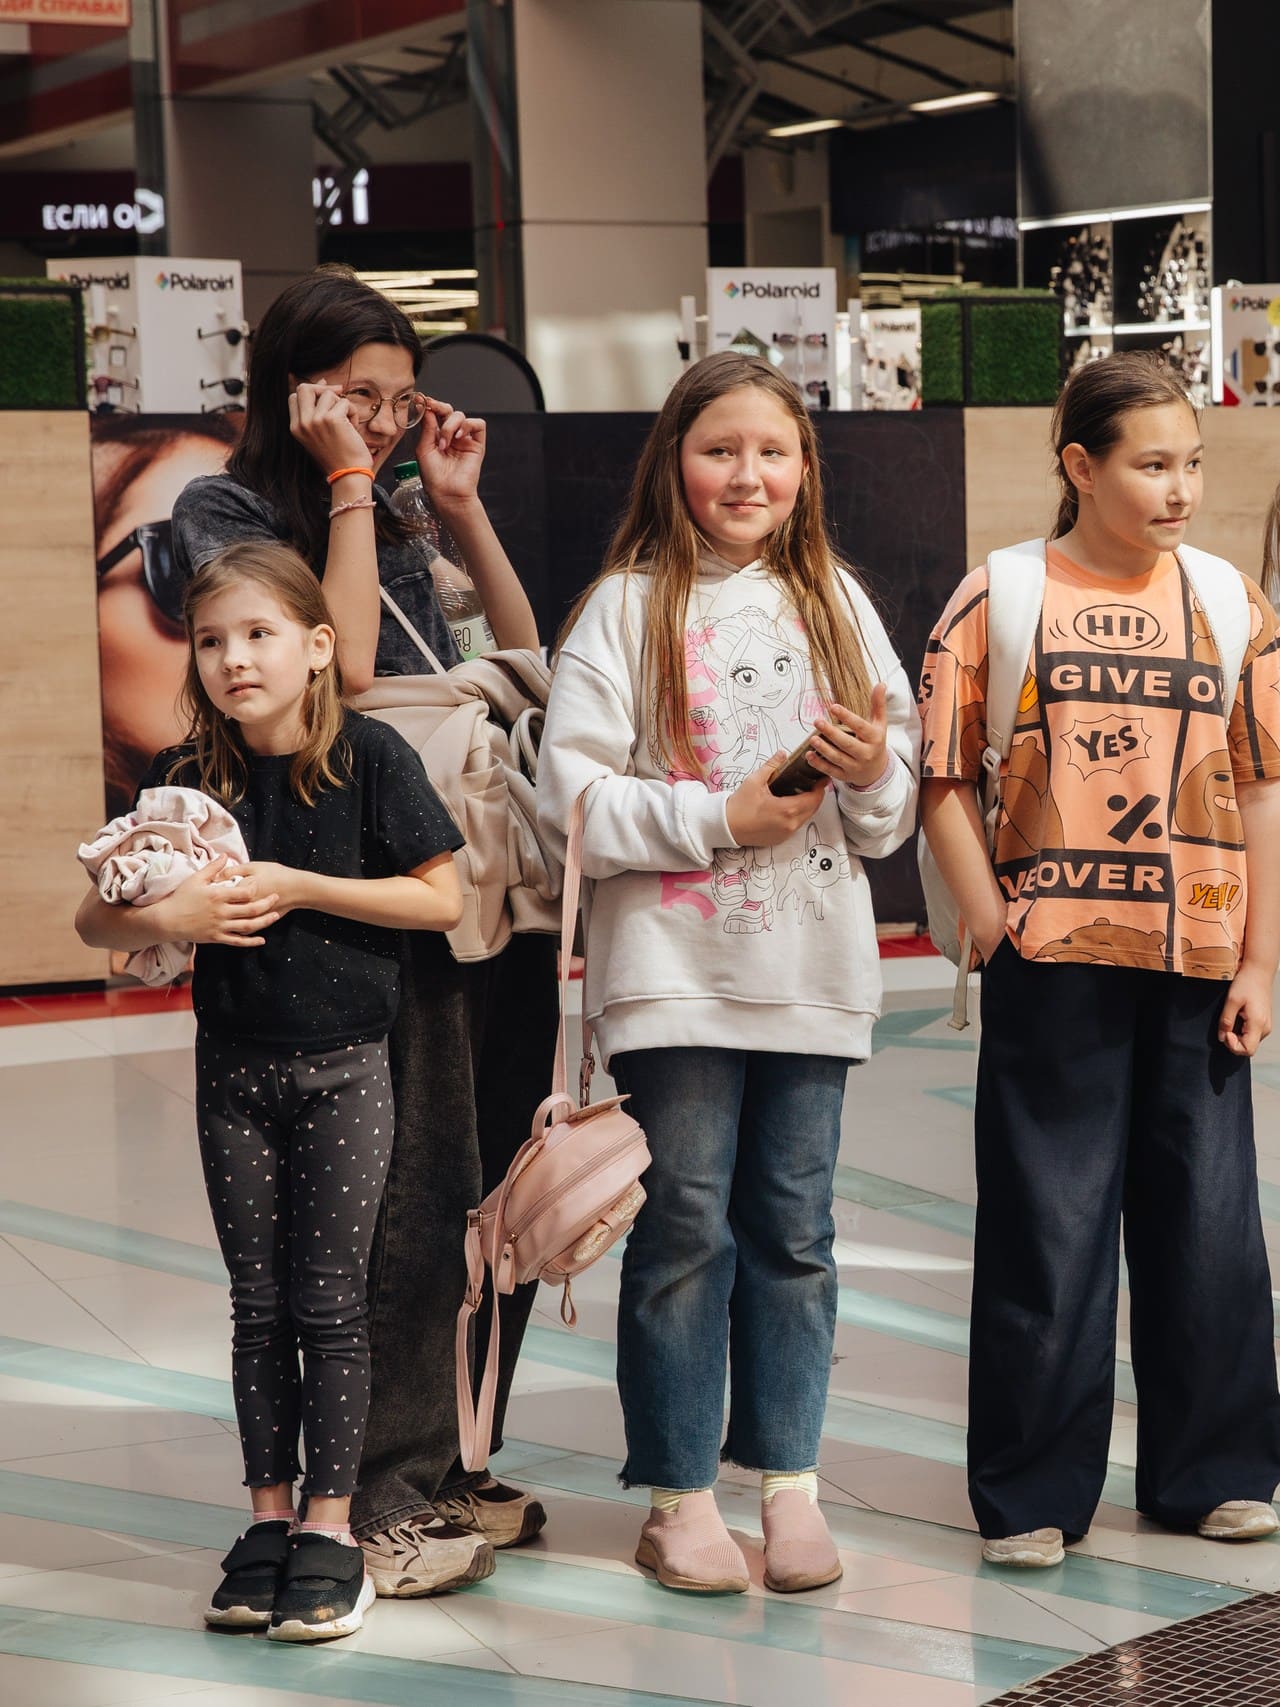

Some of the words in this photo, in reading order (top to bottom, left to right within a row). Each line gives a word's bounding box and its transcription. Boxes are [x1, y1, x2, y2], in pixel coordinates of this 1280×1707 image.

[42, 204, 109, 231] ЕСЛИ
[170, 272, 234, 291] Polaroid
[741, 282, 820, 300] Polaroid
[1086, 614, 1146, 642] HI!
[1050, 663, 1172, 698] GIVE
[1187, 674, 1225, 704] O
[1074, 724, 1140, 763] YES
[1037, 860, 1166, 893] OVER
